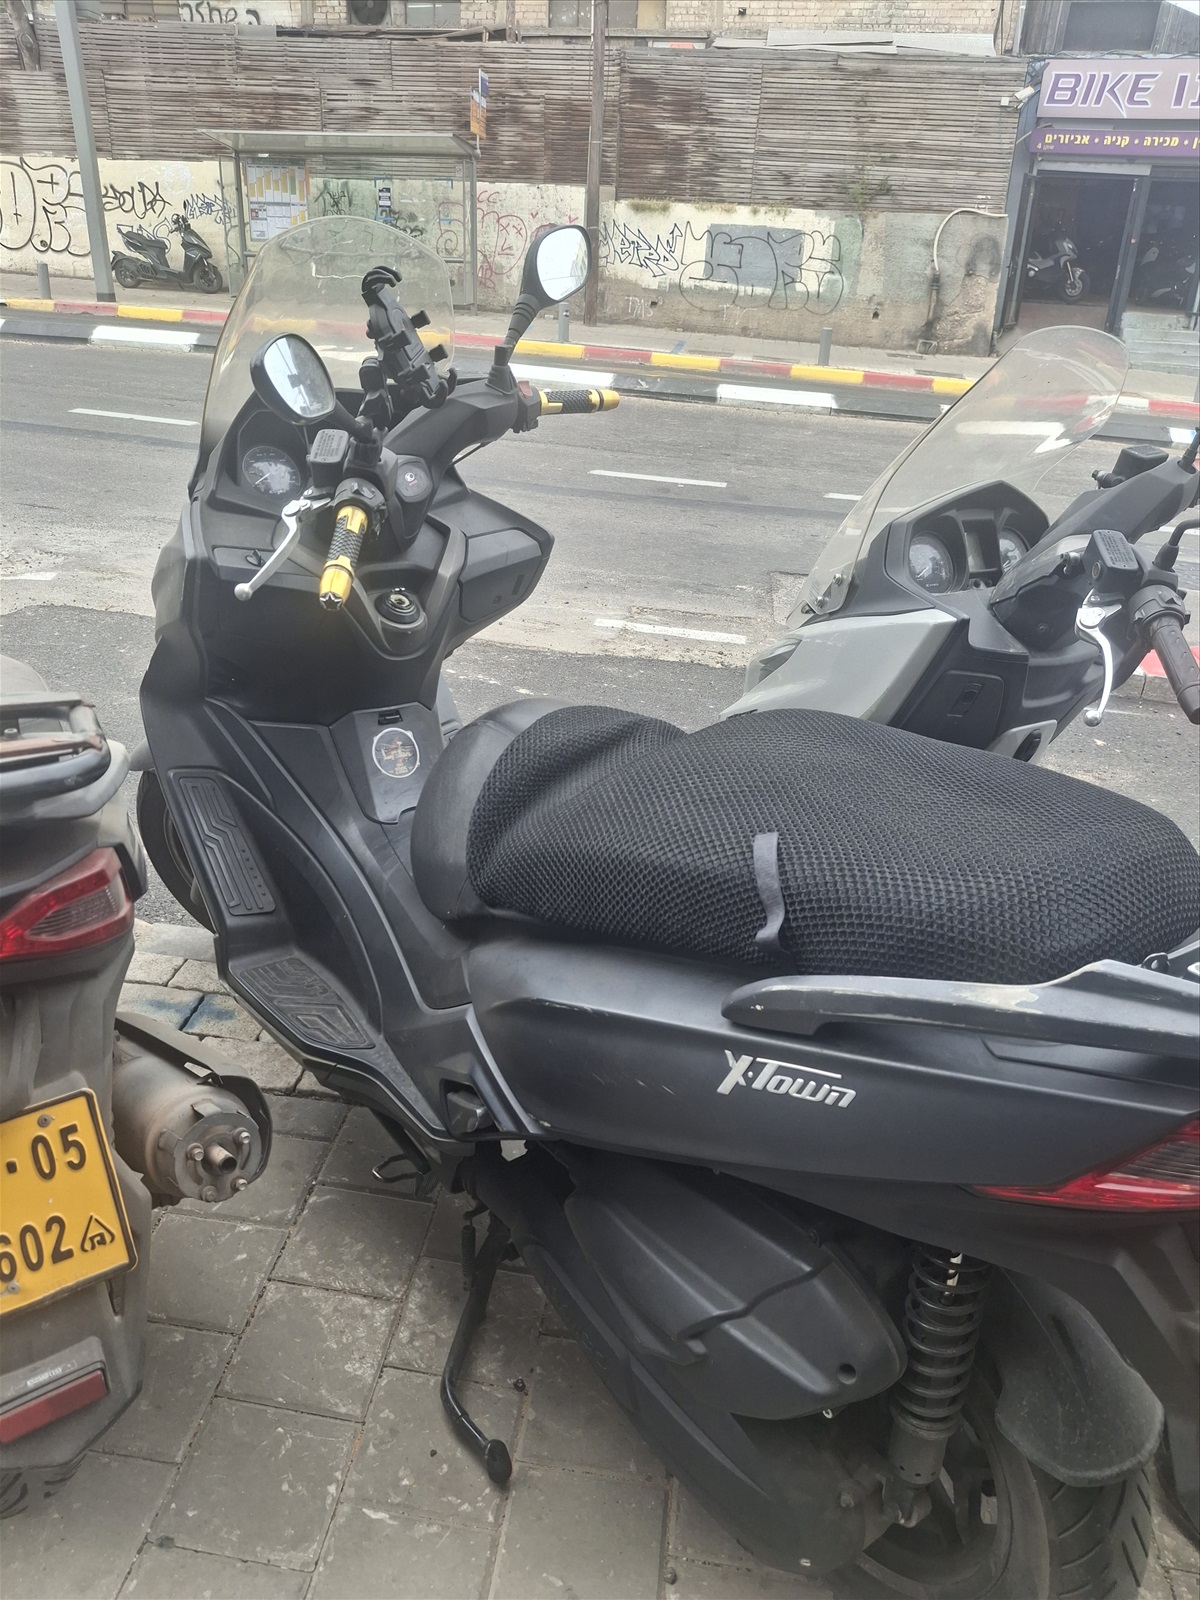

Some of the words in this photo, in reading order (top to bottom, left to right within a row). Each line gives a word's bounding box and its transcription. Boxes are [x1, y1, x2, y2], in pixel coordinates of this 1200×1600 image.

[1044, 71, 1162, 118] BIKE
[1045, 134, 1090, 144] אביזרים
[1103, 136, 1130, 148] קניה
[1143, 136, 1179, 147] מכירה
[0, 1215, 74, 1282] 602
